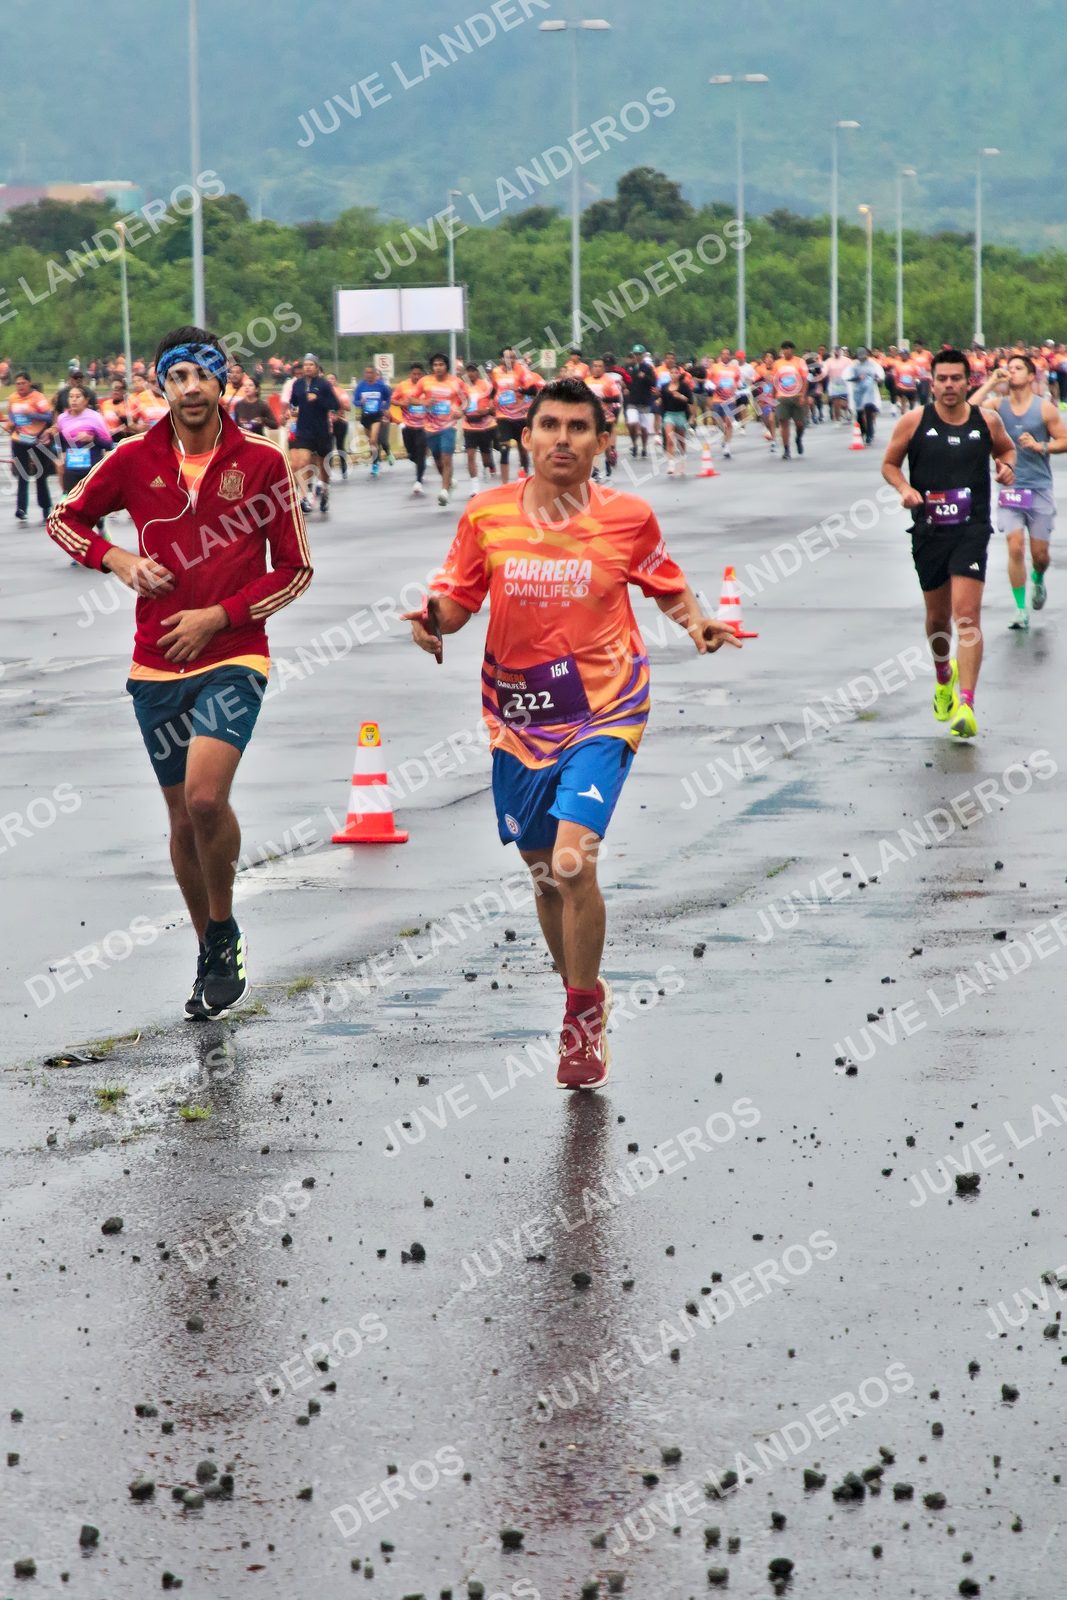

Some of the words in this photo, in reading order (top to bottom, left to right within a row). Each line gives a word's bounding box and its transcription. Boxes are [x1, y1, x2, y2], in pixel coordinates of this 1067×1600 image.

[935, 503, 958, 516] 420
[504, 557, 592, 583] CARRERA
[504, 582, 570, 598] OMNILIFE
[550, 661, 569, 679] 15K
[512, 691, 554, 710] 222
